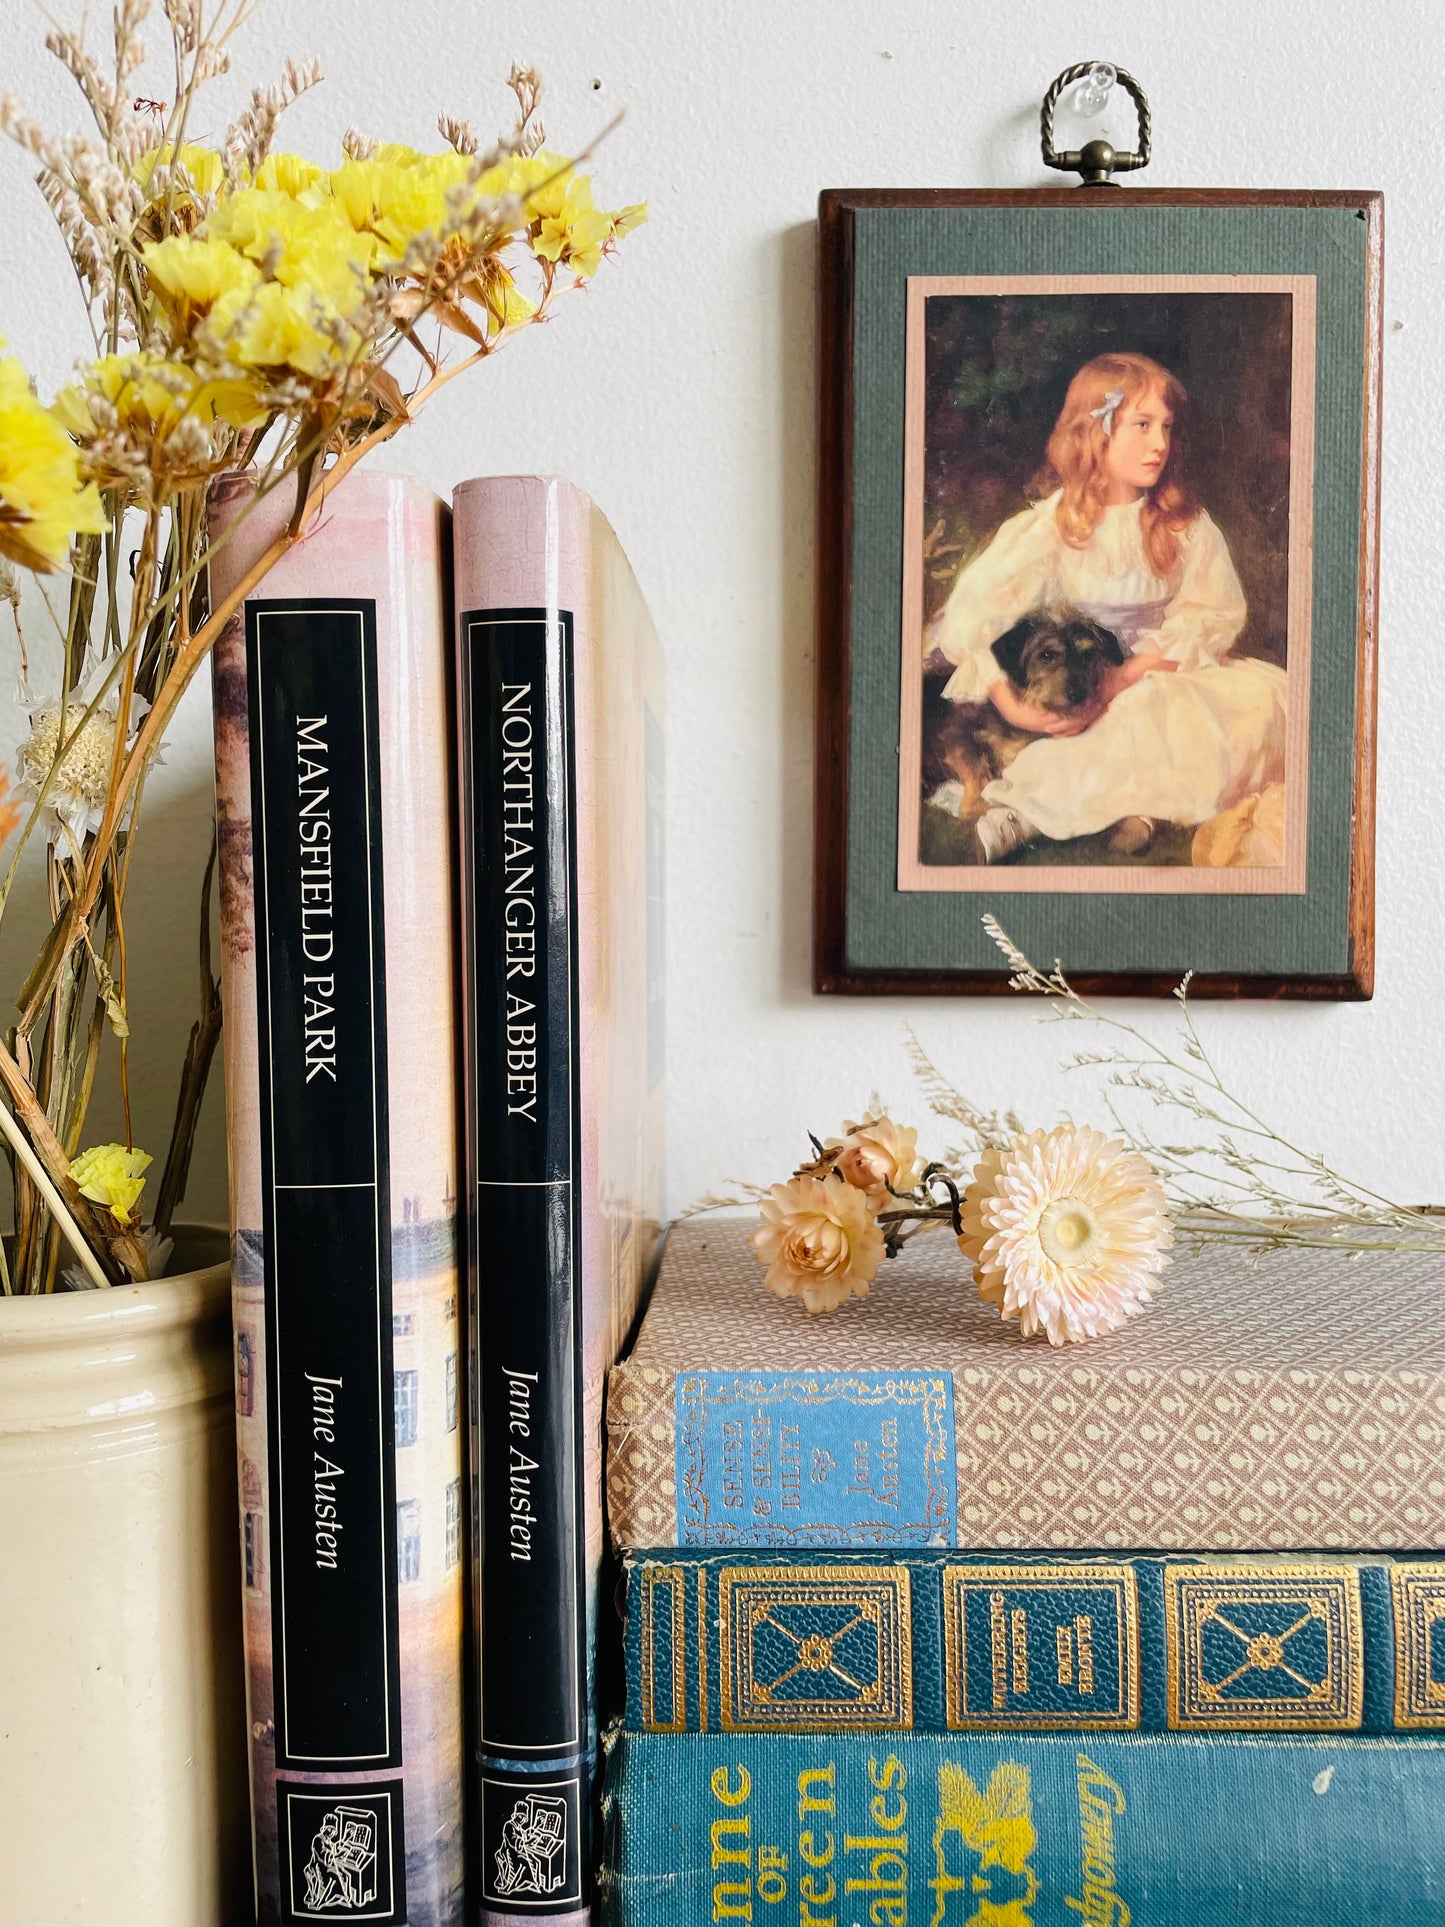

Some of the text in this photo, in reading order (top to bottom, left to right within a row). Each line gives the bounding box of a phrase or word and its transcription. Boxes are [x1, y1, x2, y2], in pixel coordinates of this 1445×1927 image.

[296, 714, 337, 1085] MANSFIELD PARK
[501, 682, 537, 1123] NORTHANGER ABBEY
[304, 1371, 345, 1569] Jane Austen
[501, 1366, 540, 1562] Jane Austen
[723, 1419, 744, 1509] SENSE
[752, 1497, 772, 1517] &
[780, 1418, 801, 1510] BILITY
[847, 1438, 875, 1496] Jane
[875, 1417, 899, 1510] Austen
[989, 1591, 1007, 1709] WUTHERING
[1011, 1608, 1029, 1694] HEIGHTS
[1056, 1625, 1073, 1685] EMILY
[710, 1762, 752, 1927] nne
[757, 1846, 789, 1903] OF
[798, 1760, 836, 1927] reen
[844, 1753, 908, 1927] ables
